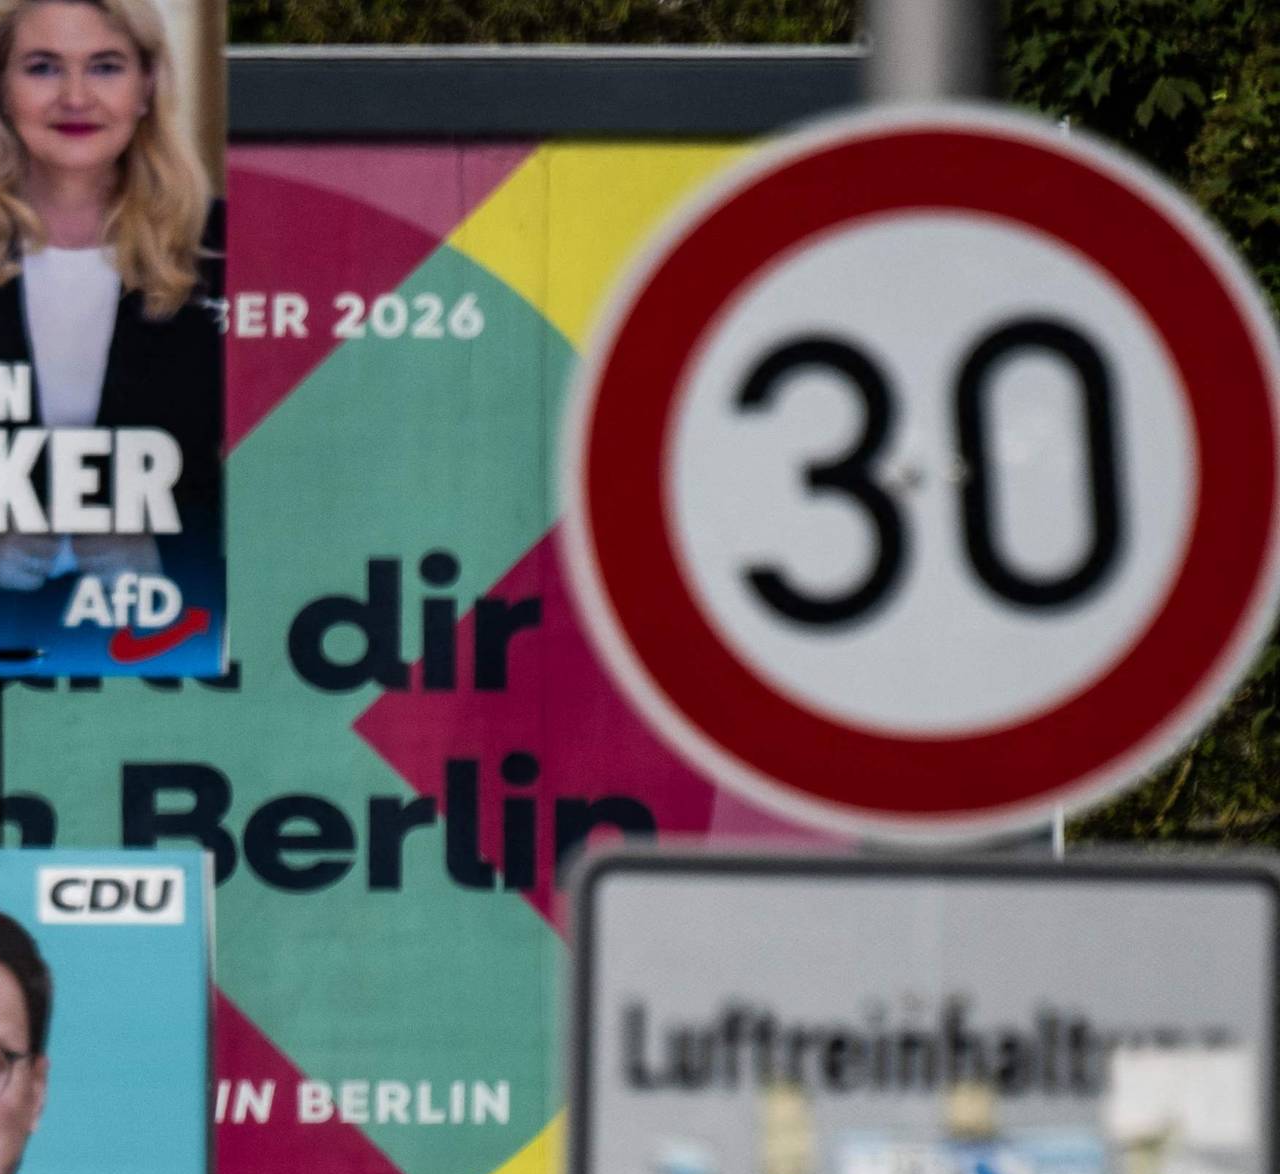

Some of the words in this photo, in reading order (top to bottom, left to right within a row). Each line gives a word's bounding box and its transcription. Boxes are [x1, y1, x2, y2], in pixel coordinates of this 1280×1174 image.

[332, 292, 485, 338] 2026
[733, 313, 1126, 640] 30
[63, 574, 183, 629] AfD
[286, 547, 545, 695] dir
[49, 877, 174, 914] CDU
[620, 995, 1238, 1094] Luftreinhalt
[296, 1080, 510, 1124] BERLIN
